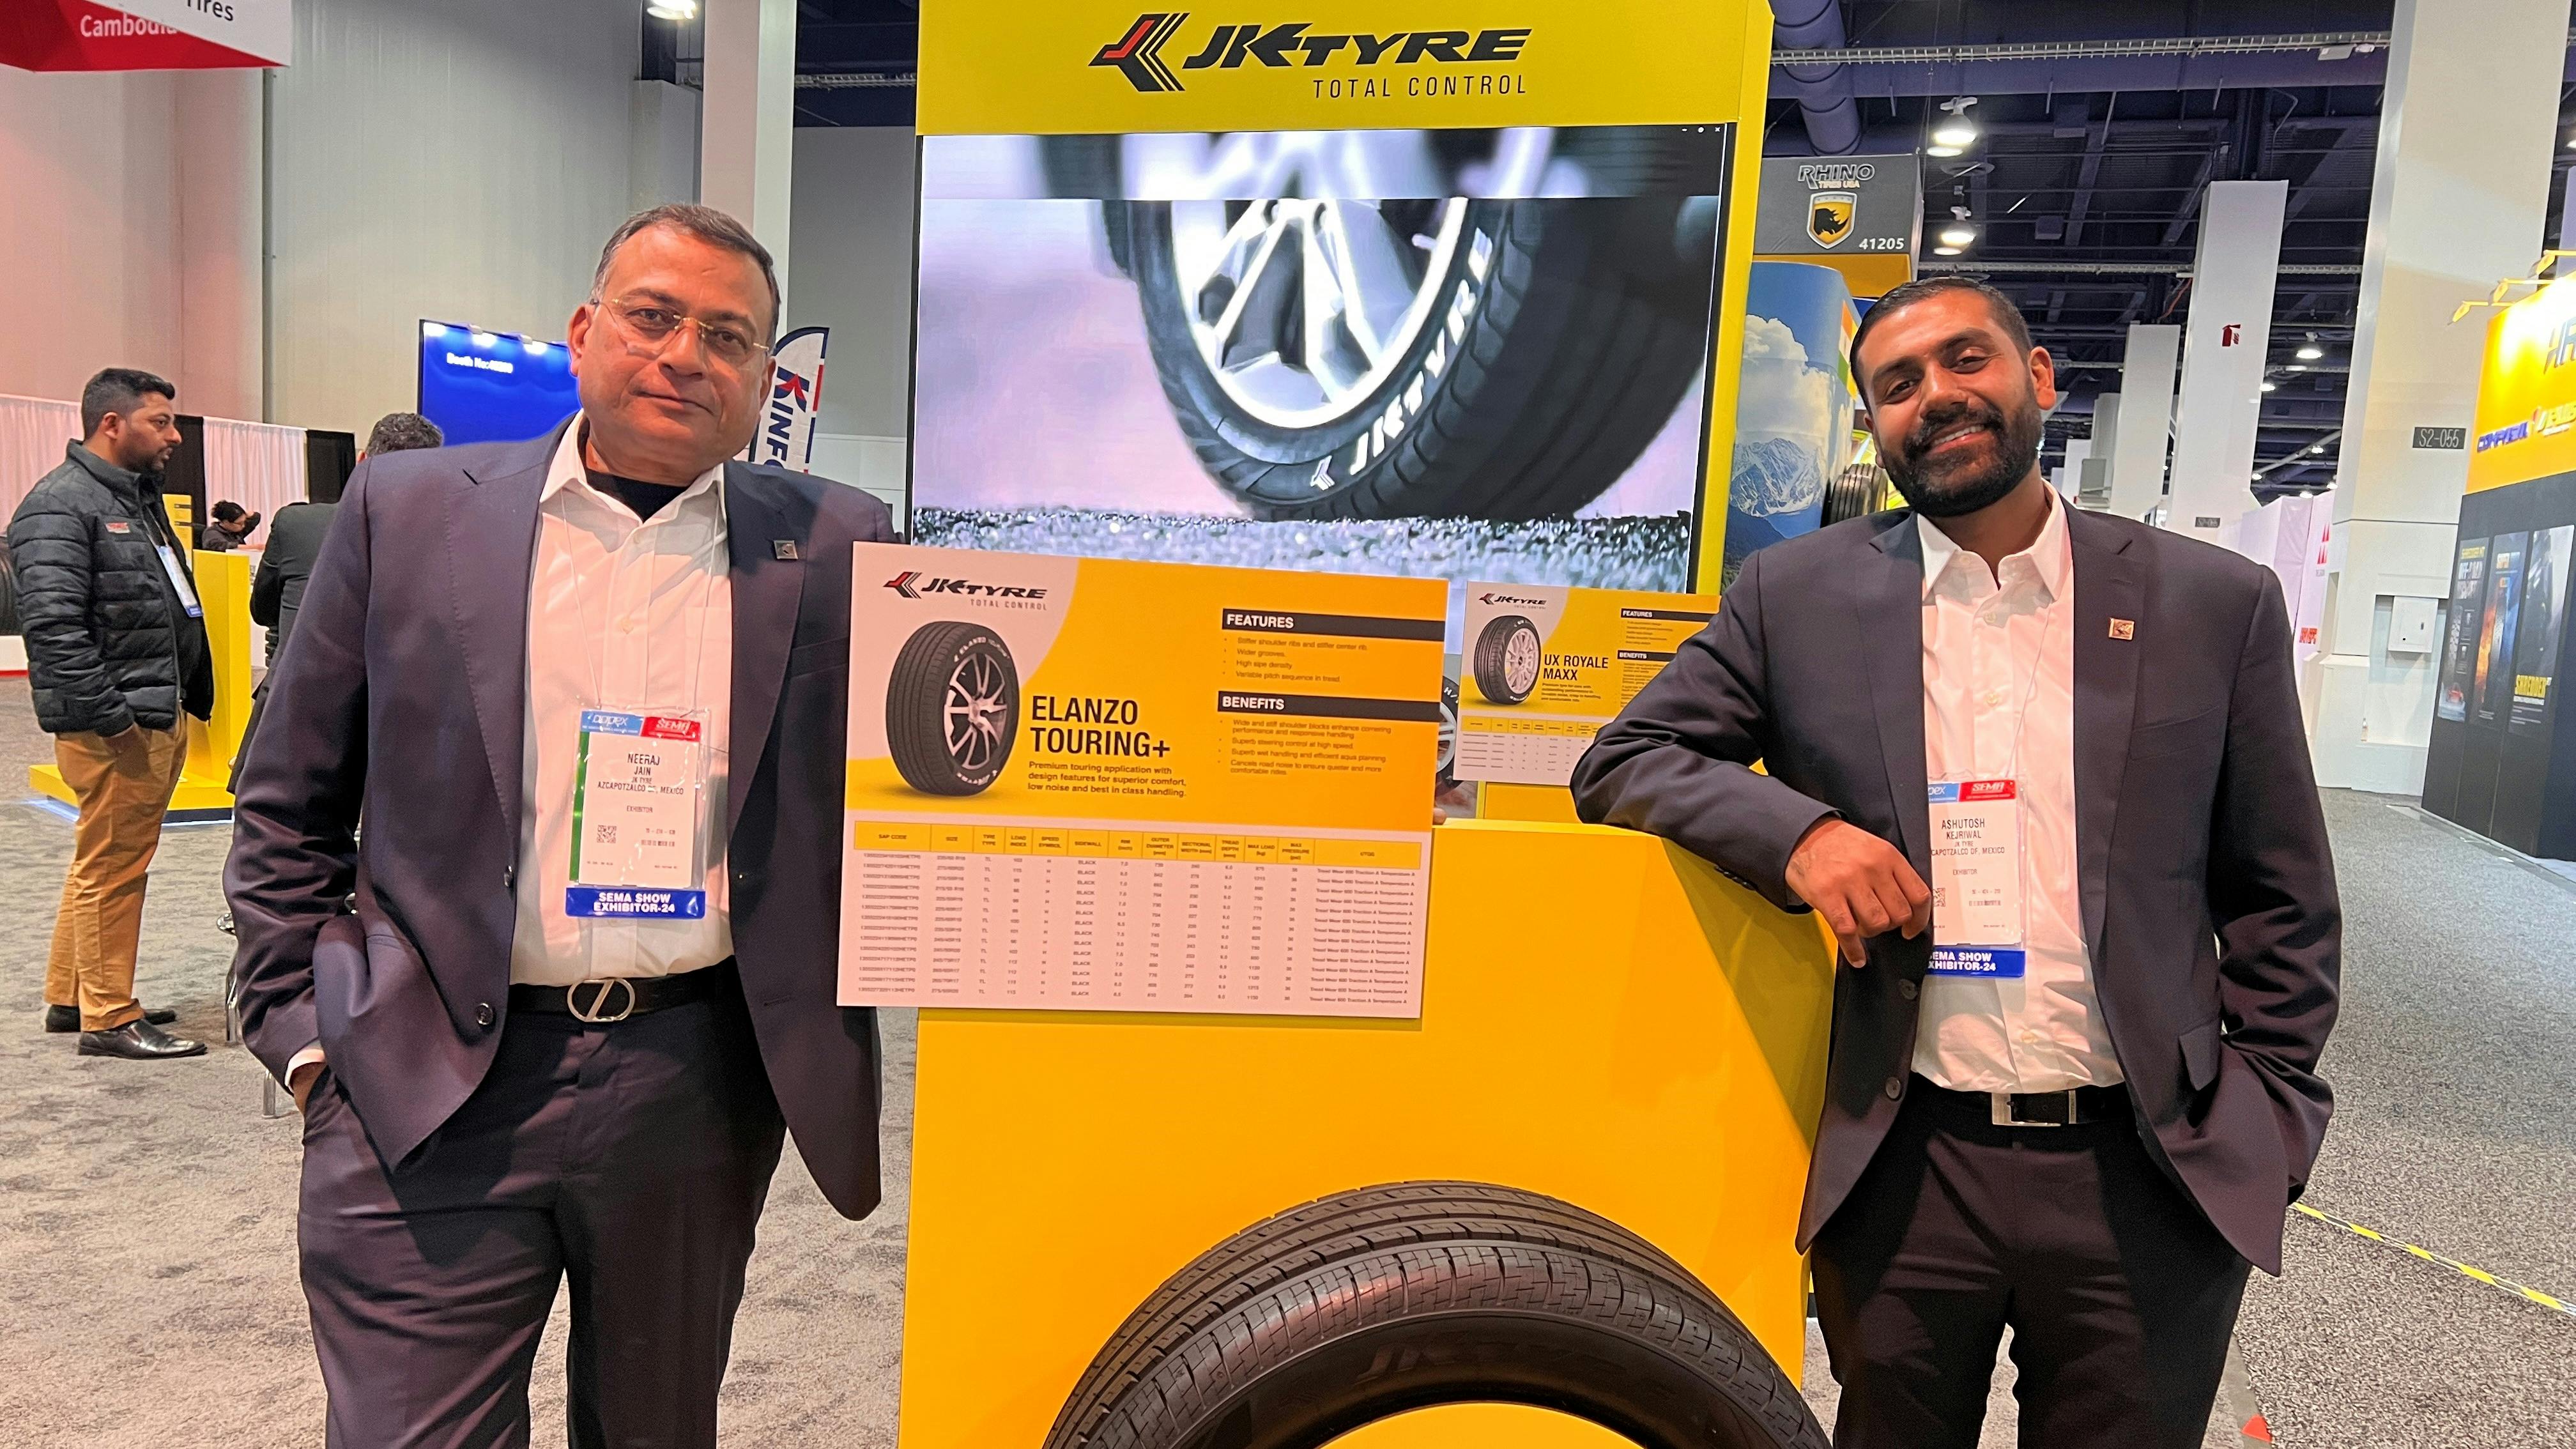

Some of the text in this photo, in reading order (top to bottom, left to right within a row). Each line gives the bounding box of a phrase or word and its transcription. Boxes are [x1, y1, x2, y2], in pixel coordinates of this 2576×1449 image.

[1313, 75, 1527, 98] TOTAL CONTROL
[1798, 164, 1875, 190] RHINO
[1859, 238, 1905, 250] 41205
[2419, 428, 2460, 447] S2-055
[970, 599, 1047, 611] TOTAL CONTROL
[1227, 613, 1294, 629] FEATURES
[1544, 654, 1609, 669] UX ROYALE
[1543, 668, 1577, 681] MAXX
[1222, 696, 1285, 710] BENEFITS
[1031, 696, 1138, 726] ELANZO
[1030, 727, 1170, 758] TOURING+
[627, 754, 660, 765] NEERAJ
[634, 766, 651, 776] JAIN
[1029, 761, 1068, 770] Premium
[1071, 763, 1101, 772] touring
[1104, 765, 1151, 774] application
[1029, 772, 1057, 781] design
[1113, 777, 1149, 785] superior
[1151, 778, 1186, 786] comfort,
[598, 781, 645, 792] AZCAPOTZALCO
[1942, 818, 1985, 829] ASHUTOSH
[1947, 831, 1981, 839] KEJRIWAL
[599, 893, 671, 903] SEMA SHOW
[1930, 952, 1992, 962] EMA SHOW
